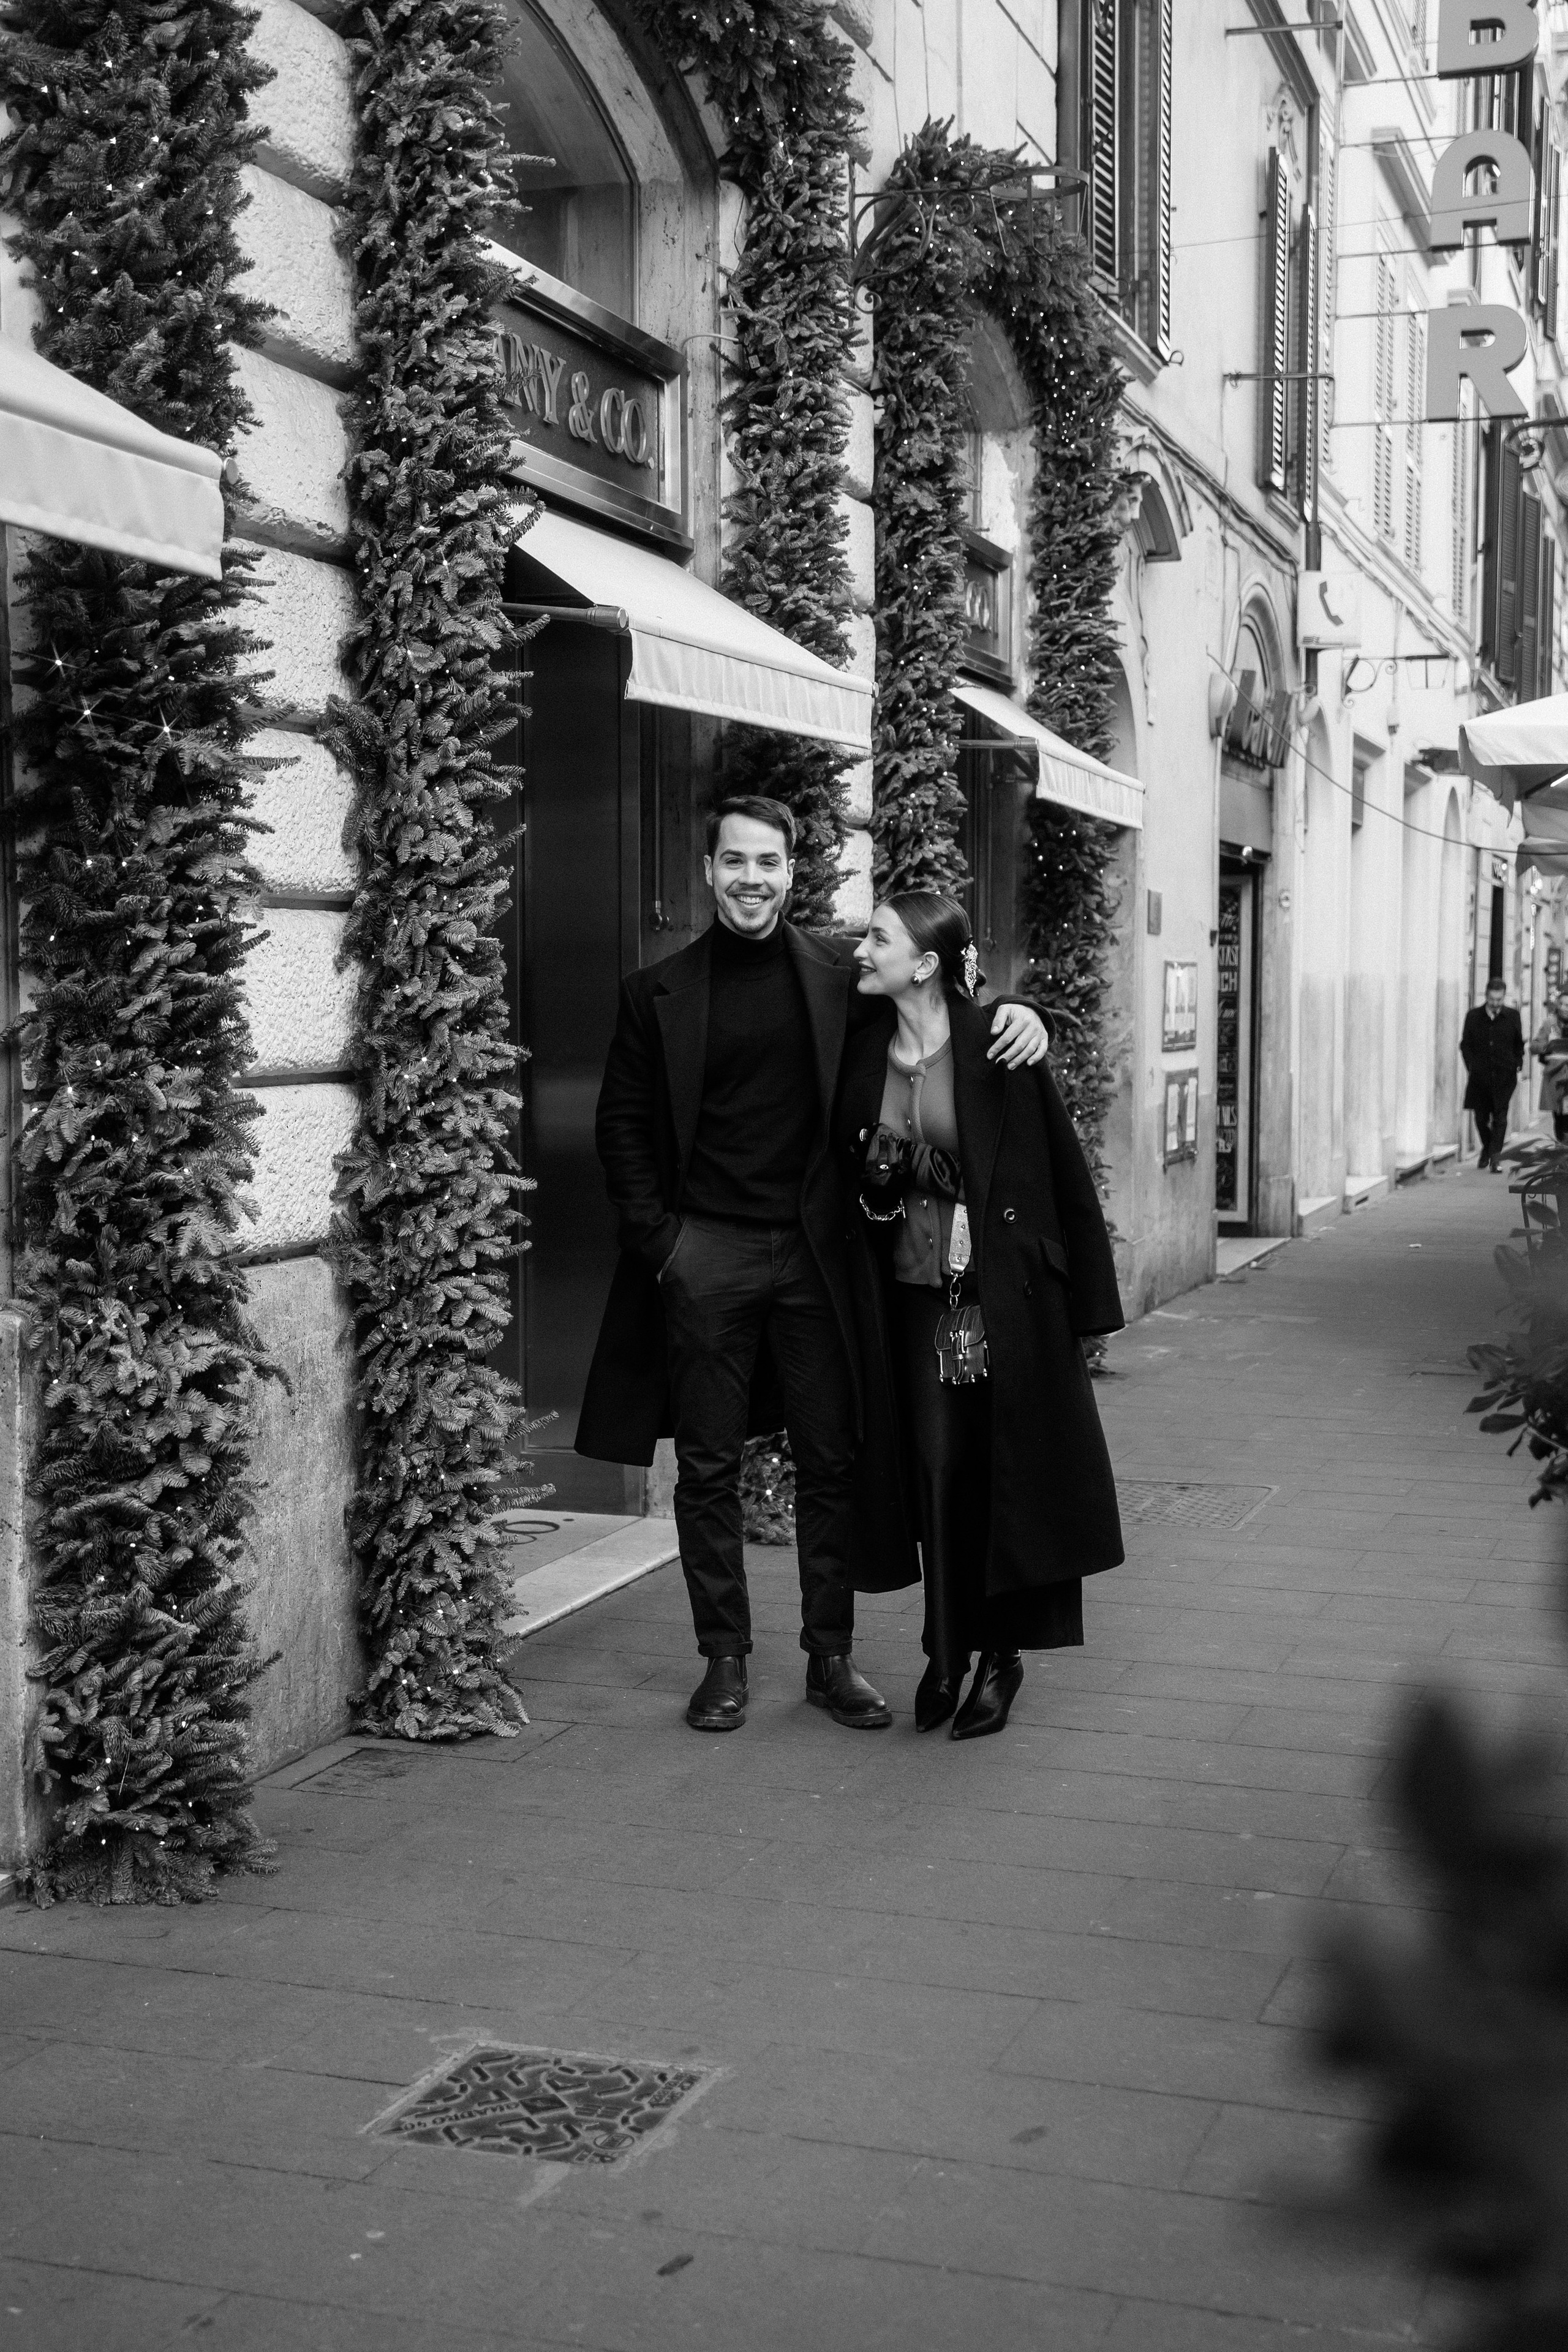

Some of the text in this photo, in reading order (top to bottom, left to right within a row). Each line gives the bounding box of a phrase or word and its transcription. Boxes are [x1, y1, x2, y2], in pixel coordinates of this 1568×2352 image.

[1426, 0, 1539, 420] BAR
[569, 371, 597, 444] &
[600, 388, 655, 470] CO.
